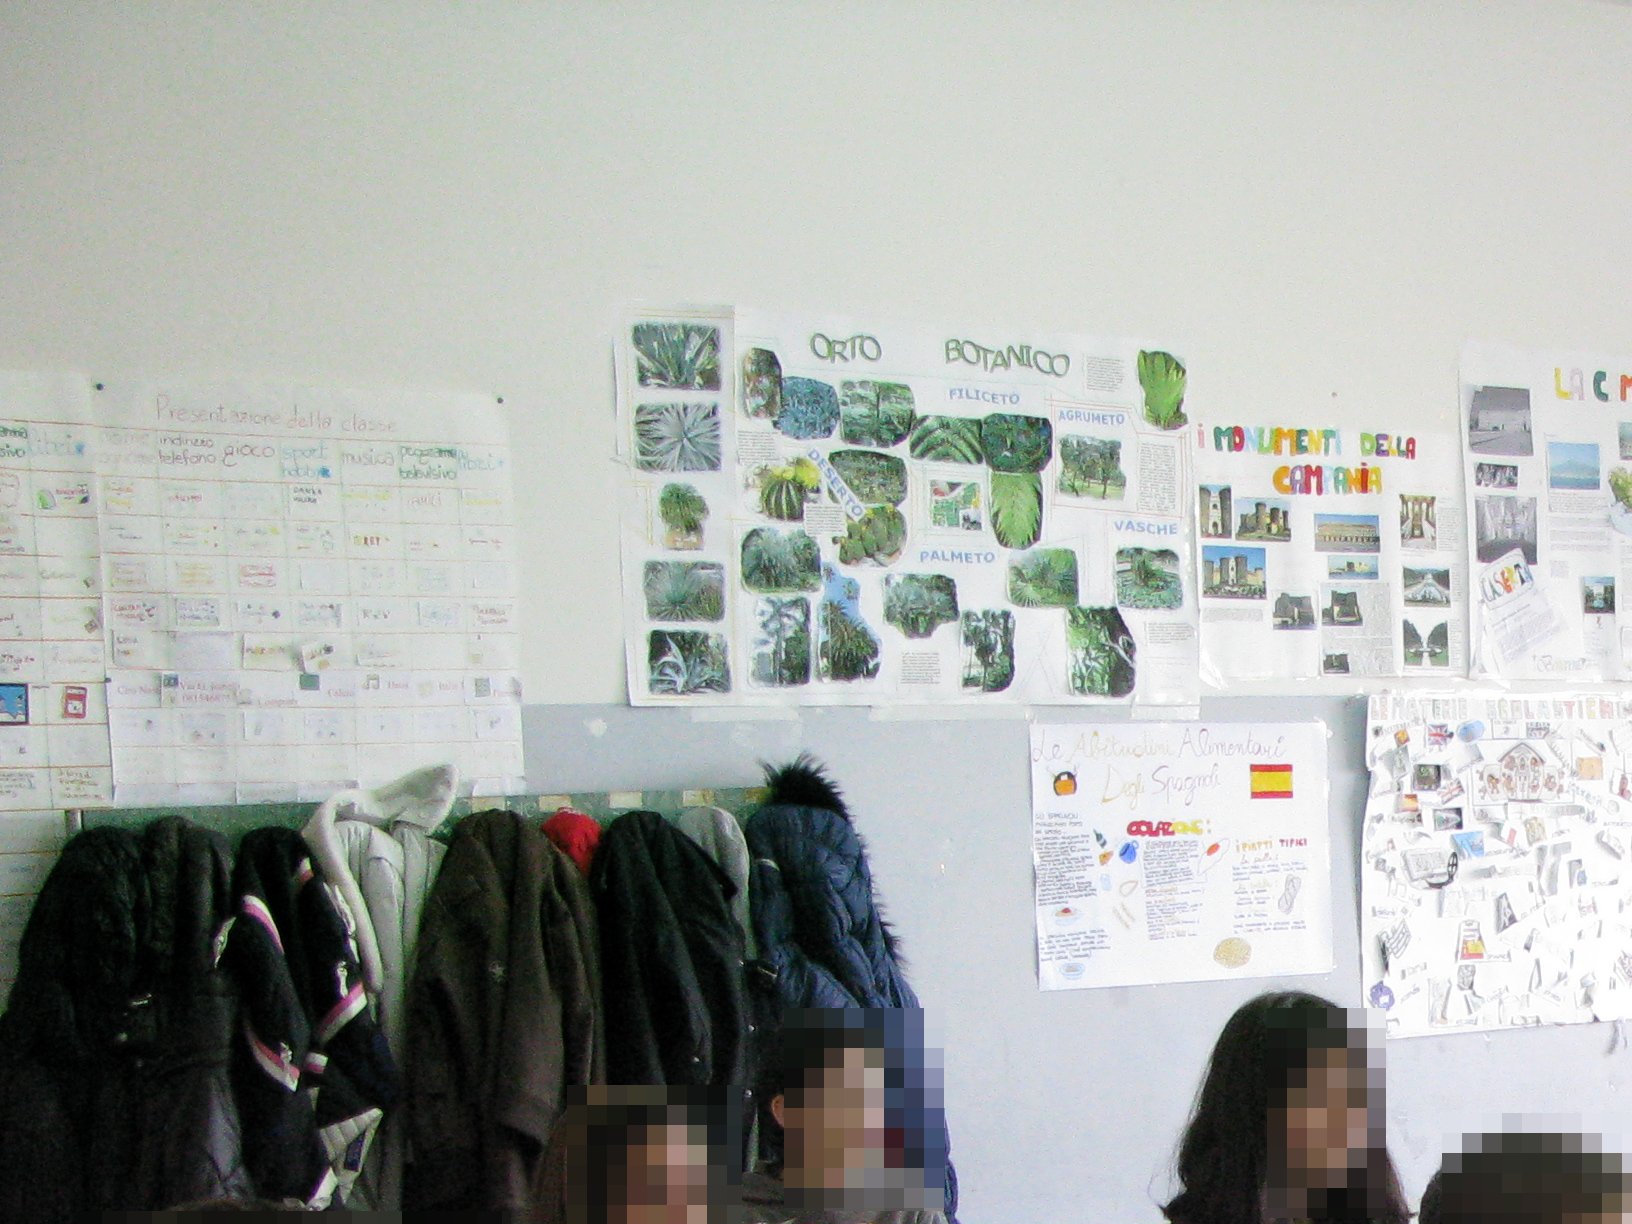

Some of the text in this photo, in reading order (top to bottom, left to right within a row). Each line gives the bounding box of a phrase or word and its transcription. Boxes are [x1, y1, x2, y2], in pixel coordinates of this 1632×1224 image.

[809, 332, 882, 363] ORTO
[945, 339, 1070, 377] BOTANICO
[1554, 367, 1585, 401] LA
[949, 387, 1021, 405] FILICETO
[1058, 410, 1125, 425] AGRUMETO
[1213, 425, 1342, 456] MONUMENTI
[1359, 432, 1417, 460] DELLA
[222, 445, 275, 467] gioco
[342, 448, 395, 467] musica
[807, 449, 865, 519] DESERTO
[1272, 462, 1384, 496] CAMPANIA
[1114, 519, 1178, 536] VASCHE
[920, 550, 996, 564] PALMETO
